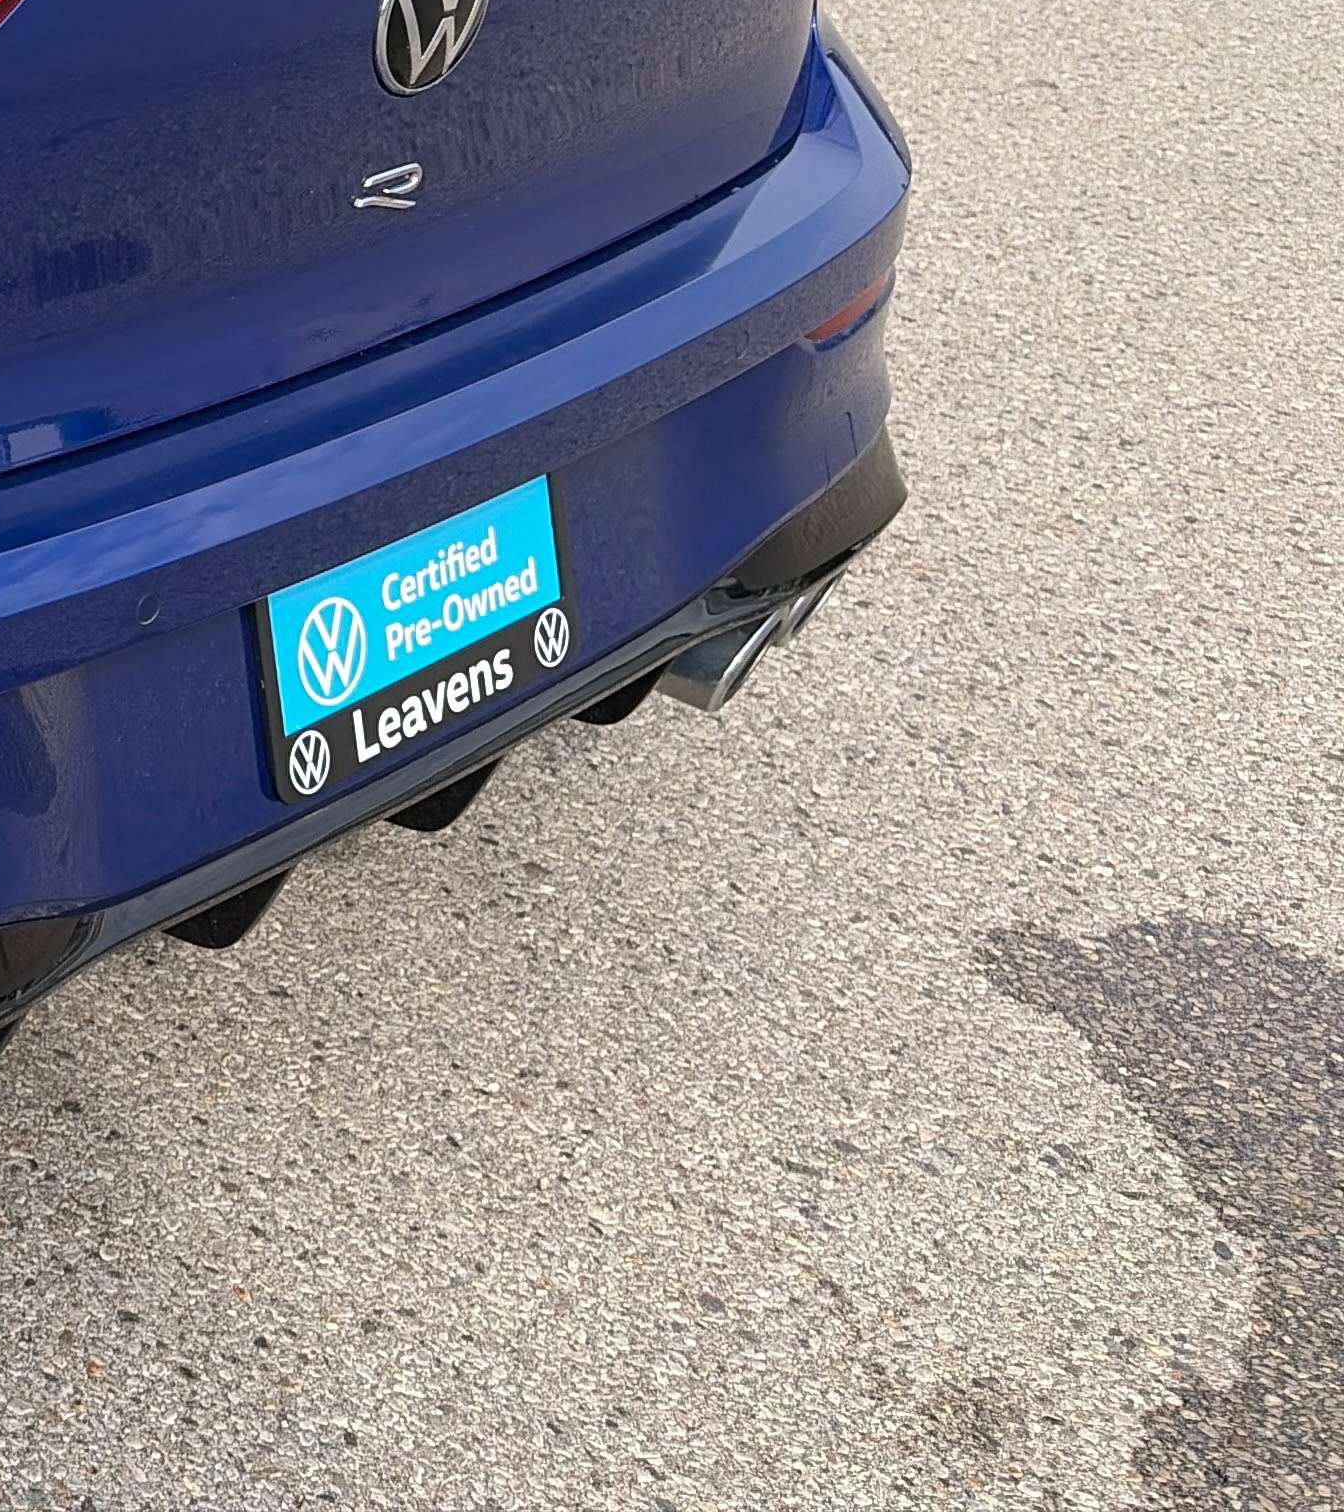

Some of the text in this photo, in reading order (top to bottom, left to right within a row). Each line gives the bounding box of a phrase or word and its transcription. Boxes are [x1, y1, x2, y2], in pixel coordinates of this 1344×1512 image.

[381, 526, 498, 611] Certified
[385, 557, 538, 661] Pre-Owned
[352, 647, 514, 764] Leavens
